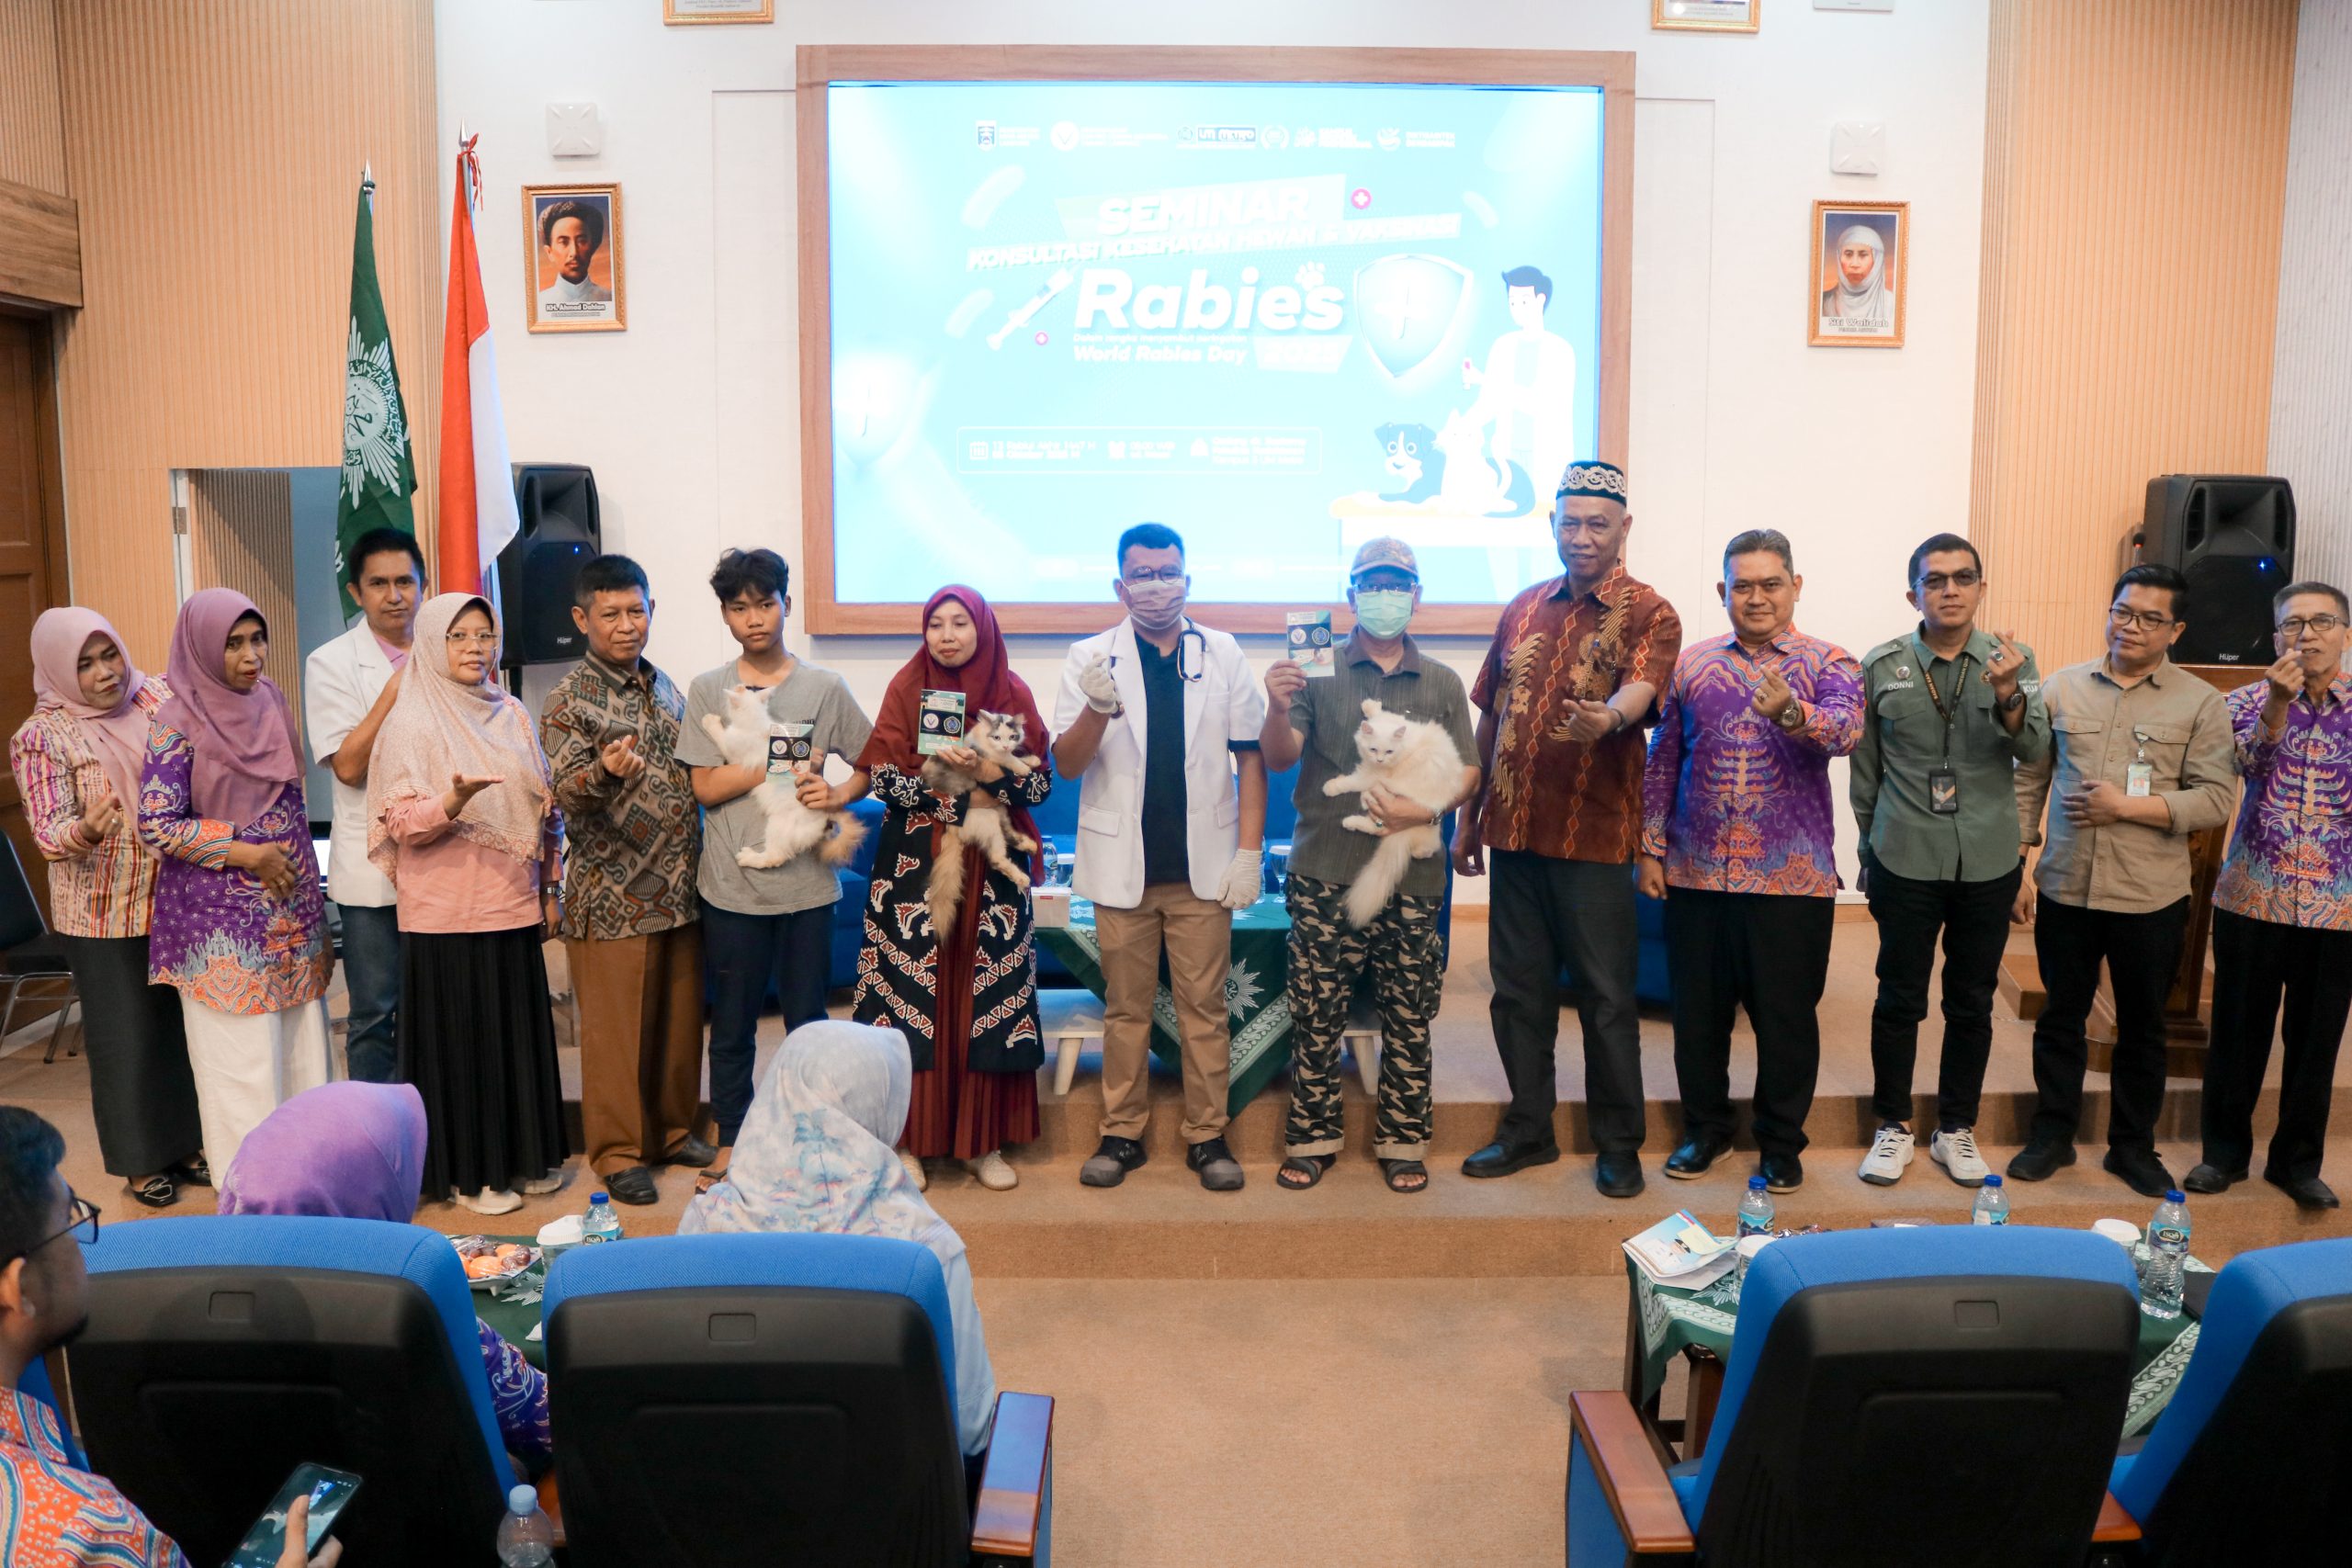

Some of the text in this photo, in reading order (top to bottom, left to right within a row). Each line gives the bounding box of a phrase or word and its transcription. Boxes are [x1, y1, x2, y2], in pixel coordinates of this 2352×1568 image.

[1098, 186, 1309, 236] SEMINAR
[967, 242, 1102, 271] KONSULTASI
[1105, 231, 1230, 259] KESEHATAN
[1237, 224, 1316, 249] HEWAN
[1074, 266, 1346, 332] Rabies
[1073, 344, 1132, 362] World
[1136, 344, 1202, 362] Rabies
[1207, 344, 1248, 366] Day
[1887, 681, 1914, 691] DONNI
